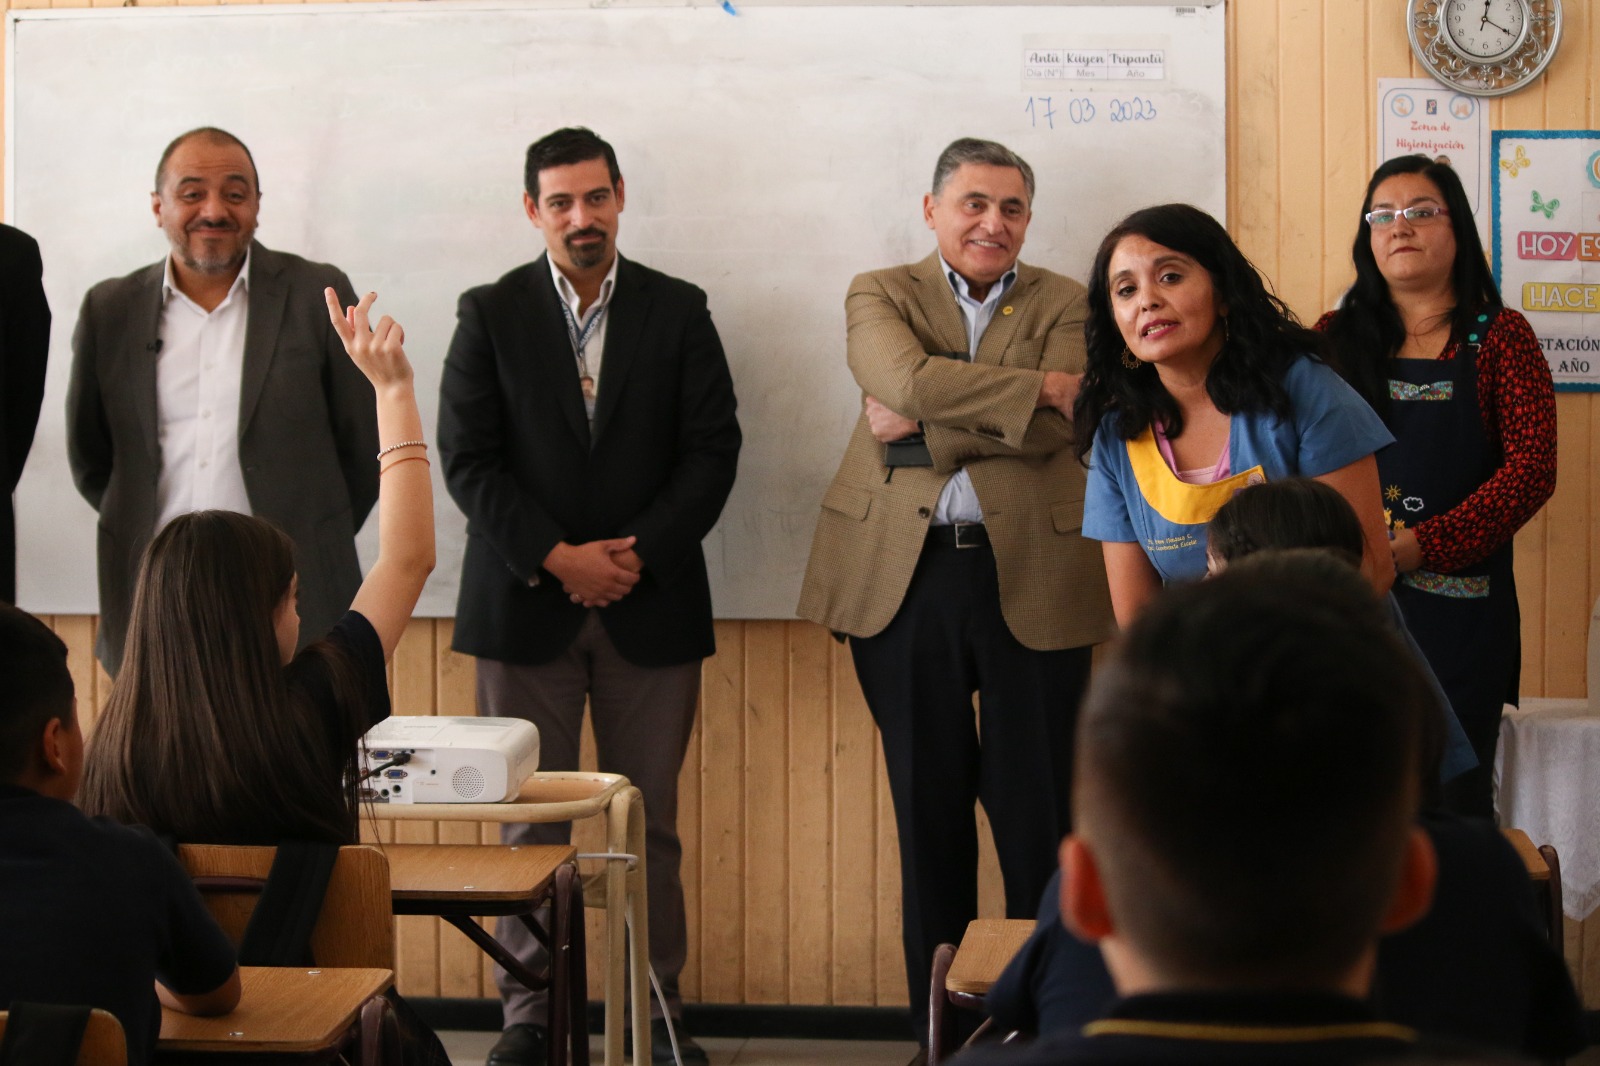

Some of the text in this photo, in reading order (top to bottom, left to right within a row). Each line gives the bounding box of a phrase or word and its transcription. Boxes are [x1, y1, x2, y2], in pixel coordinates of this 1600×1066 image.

[1505, 3, 1511, 11] 2
[1455, 16, 1460, 24] 9
[1458, 28, 1464, 36] 8
[1468, 38, 1475, 46] 7
[1482, 42, 1488, 50] 6
[1496, 38, 1502, 46] 5
[1126, 69, 1145, 78] Año
[1025, 96, 1157, 129] 17 03 2023
[1521, 234, 1574, 256] HOY
[1530, 286, 1598, 308] HACE
[1558, 358, 1590, 373] AÑO
